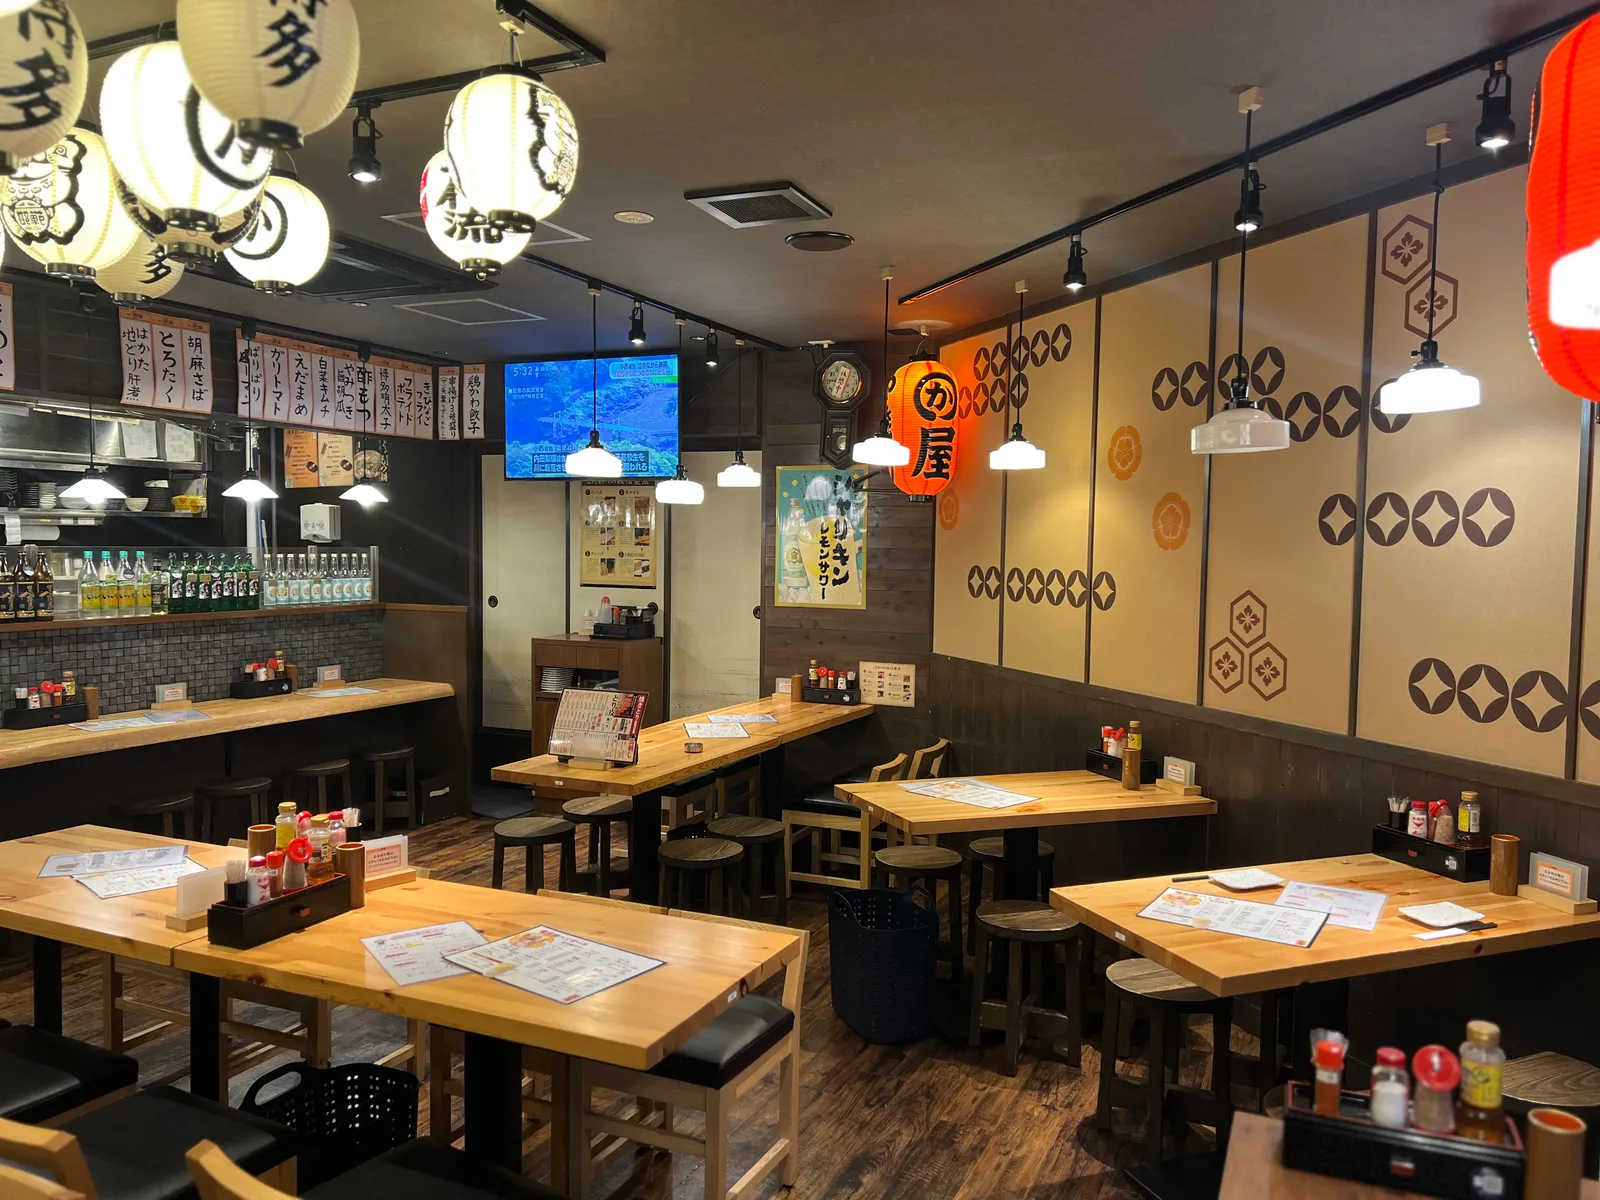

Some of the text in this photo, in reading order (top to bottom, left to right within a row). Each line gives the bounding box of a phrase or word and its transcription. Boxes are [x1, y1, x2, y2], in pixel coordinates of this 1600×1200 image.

[136, 328, 150, 372] はかた
[159, 331, 177, 404] とろたく
[188, 336, 208, 402] 胡麻さば
[250, 346, 263, 401] ぱりぱり
[513, 366, 533, 376] 5:32
[271, 348, 285, 416] ガリトマト
[294, 353, 308, 417] えだまめ
[318, 356, 330, 418] 白菜キムチ
[343, 363, 355, 420] やみつき
[356, 365, 372, 421] 酢もつ
[378, 368, 392, 430] 博多明太子
[397, 383, 405, 422] ポテト
[403, 377, 412, 426] フライド
[416, 391, 424, 425] フライ
[423, 381, 432, 427] きびなご
[467, 374, 481, 435] 鶏かわ餃子
[832, 474, 852, 587] シャリキン
[818, 522, 830, 600] レモンサワー
